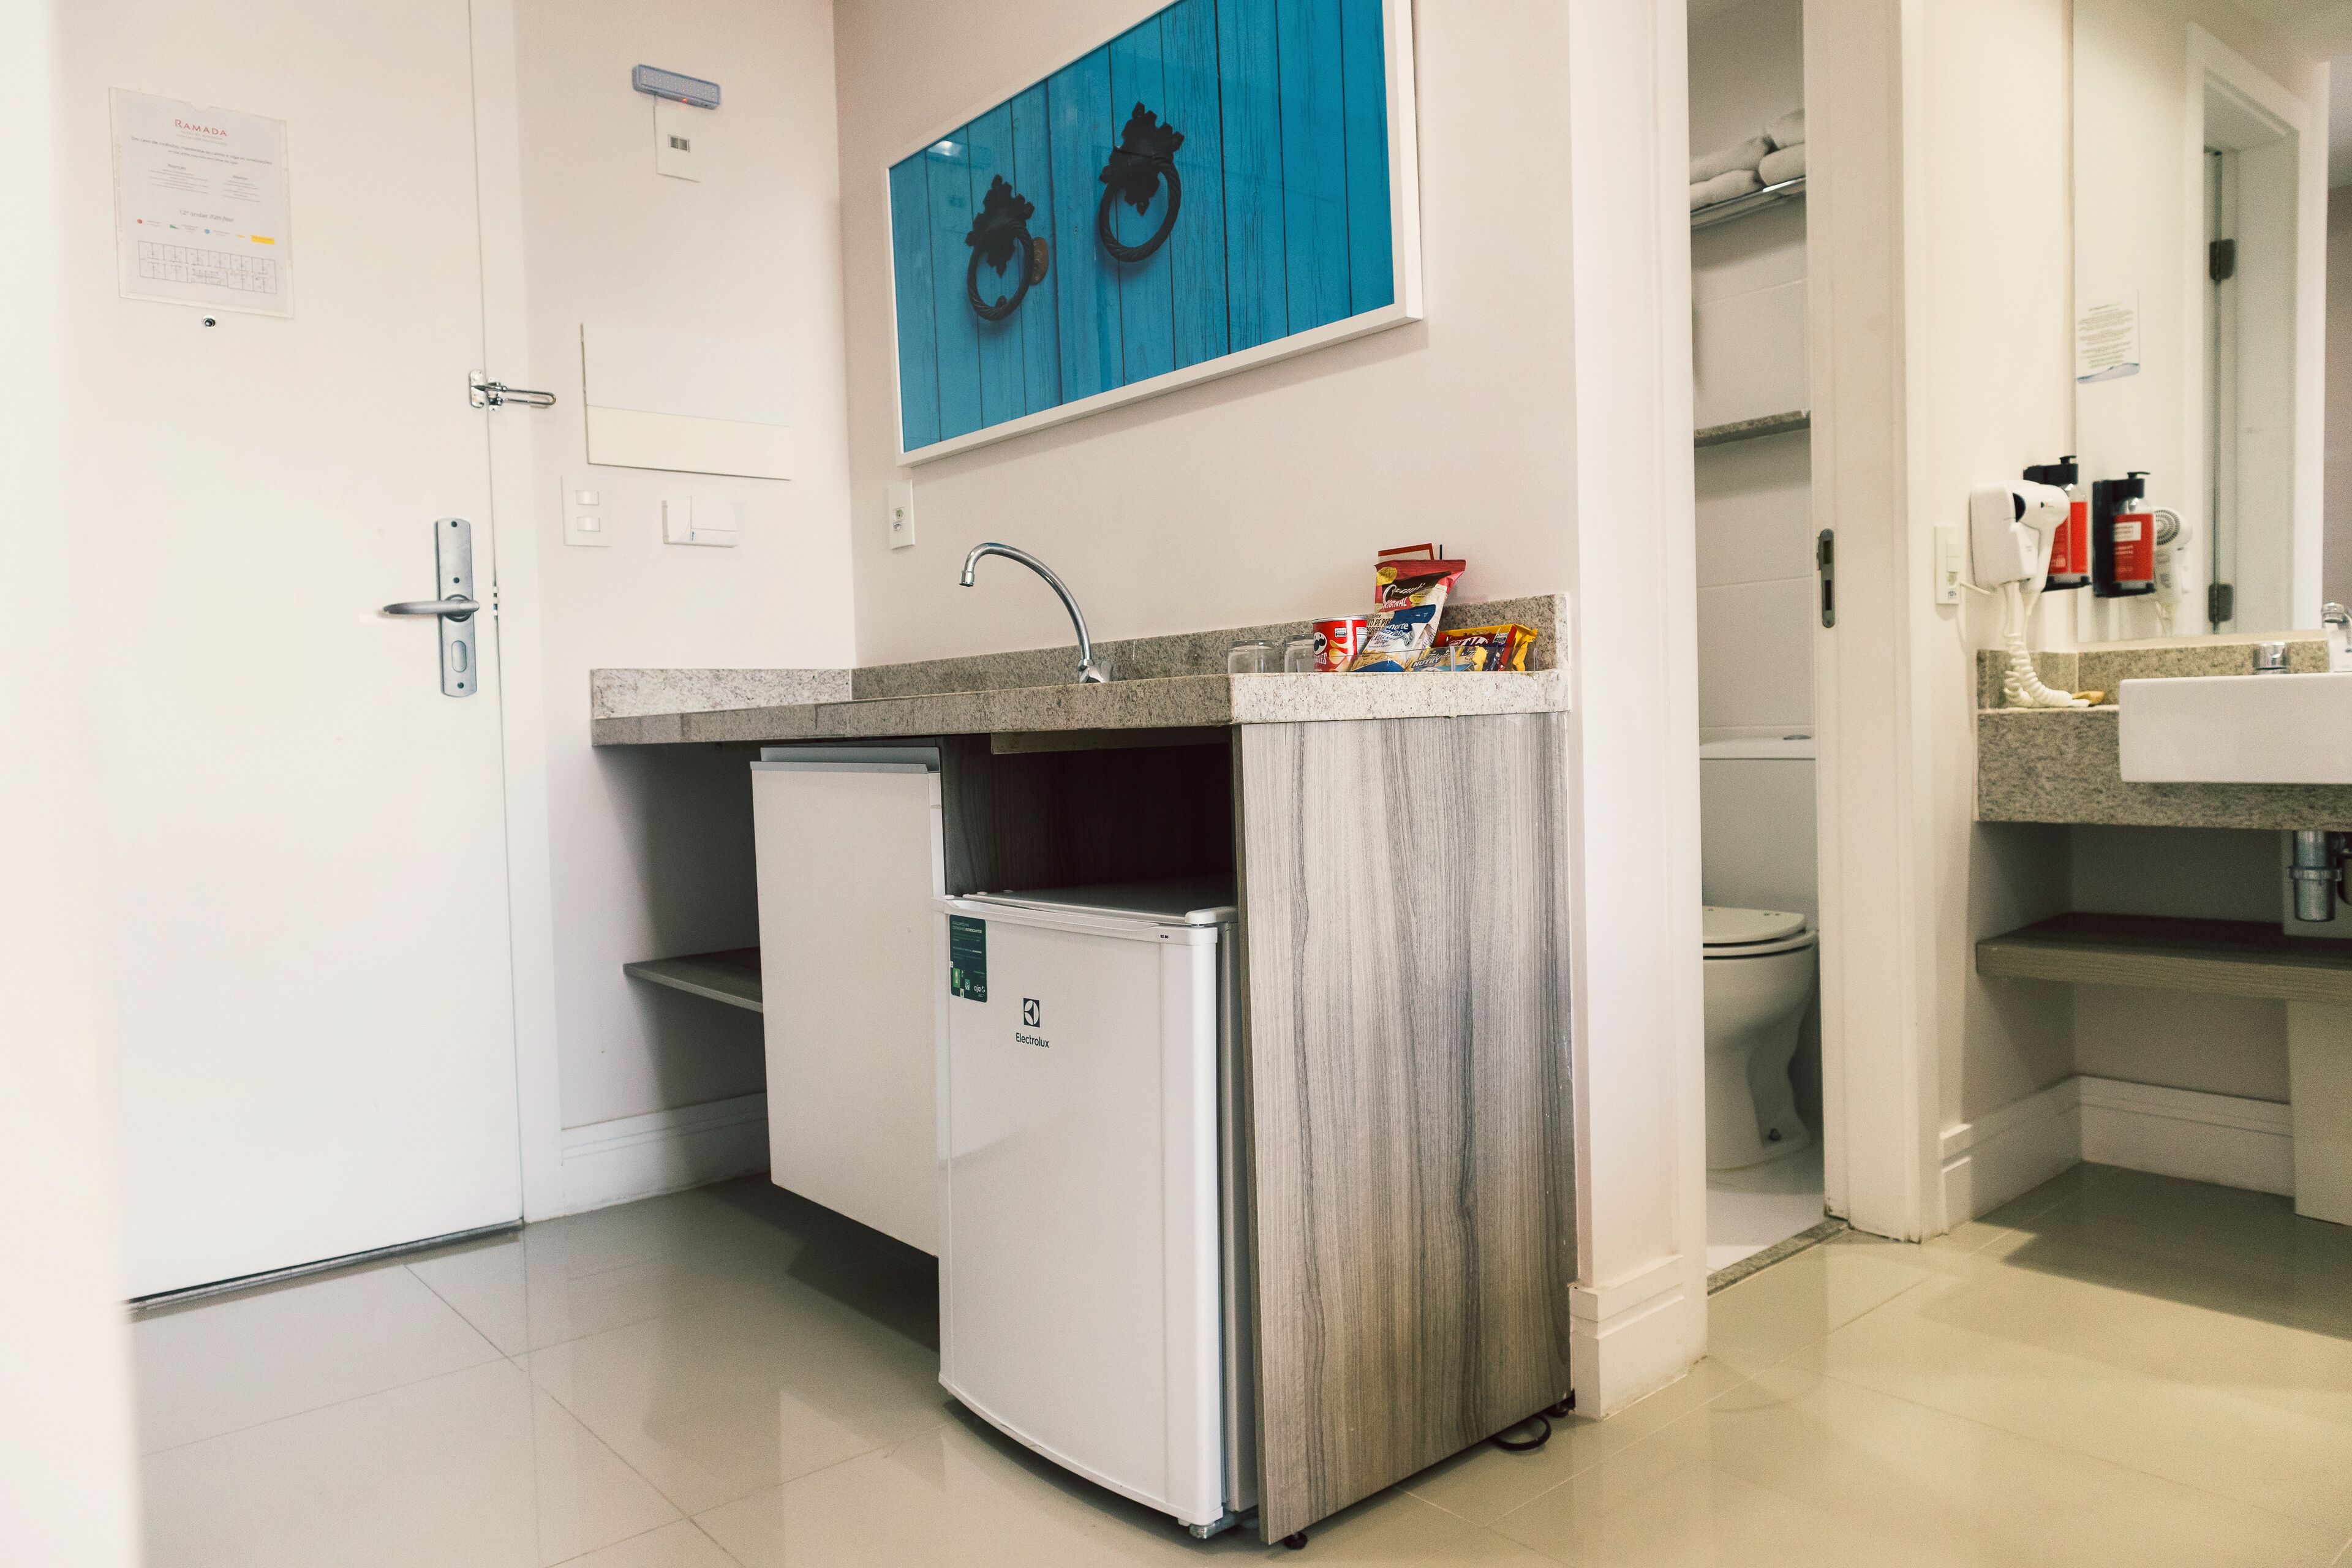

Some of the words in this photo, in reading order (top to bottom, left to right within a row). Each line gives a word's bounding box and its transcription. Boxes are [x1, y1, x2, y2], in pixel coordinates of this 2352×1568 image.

[174, 119, 227, 136] RAMADA
[1412, 657, 1441, 668] NUTRY
[1016, 1032, 1049, 1048] Electrolux
